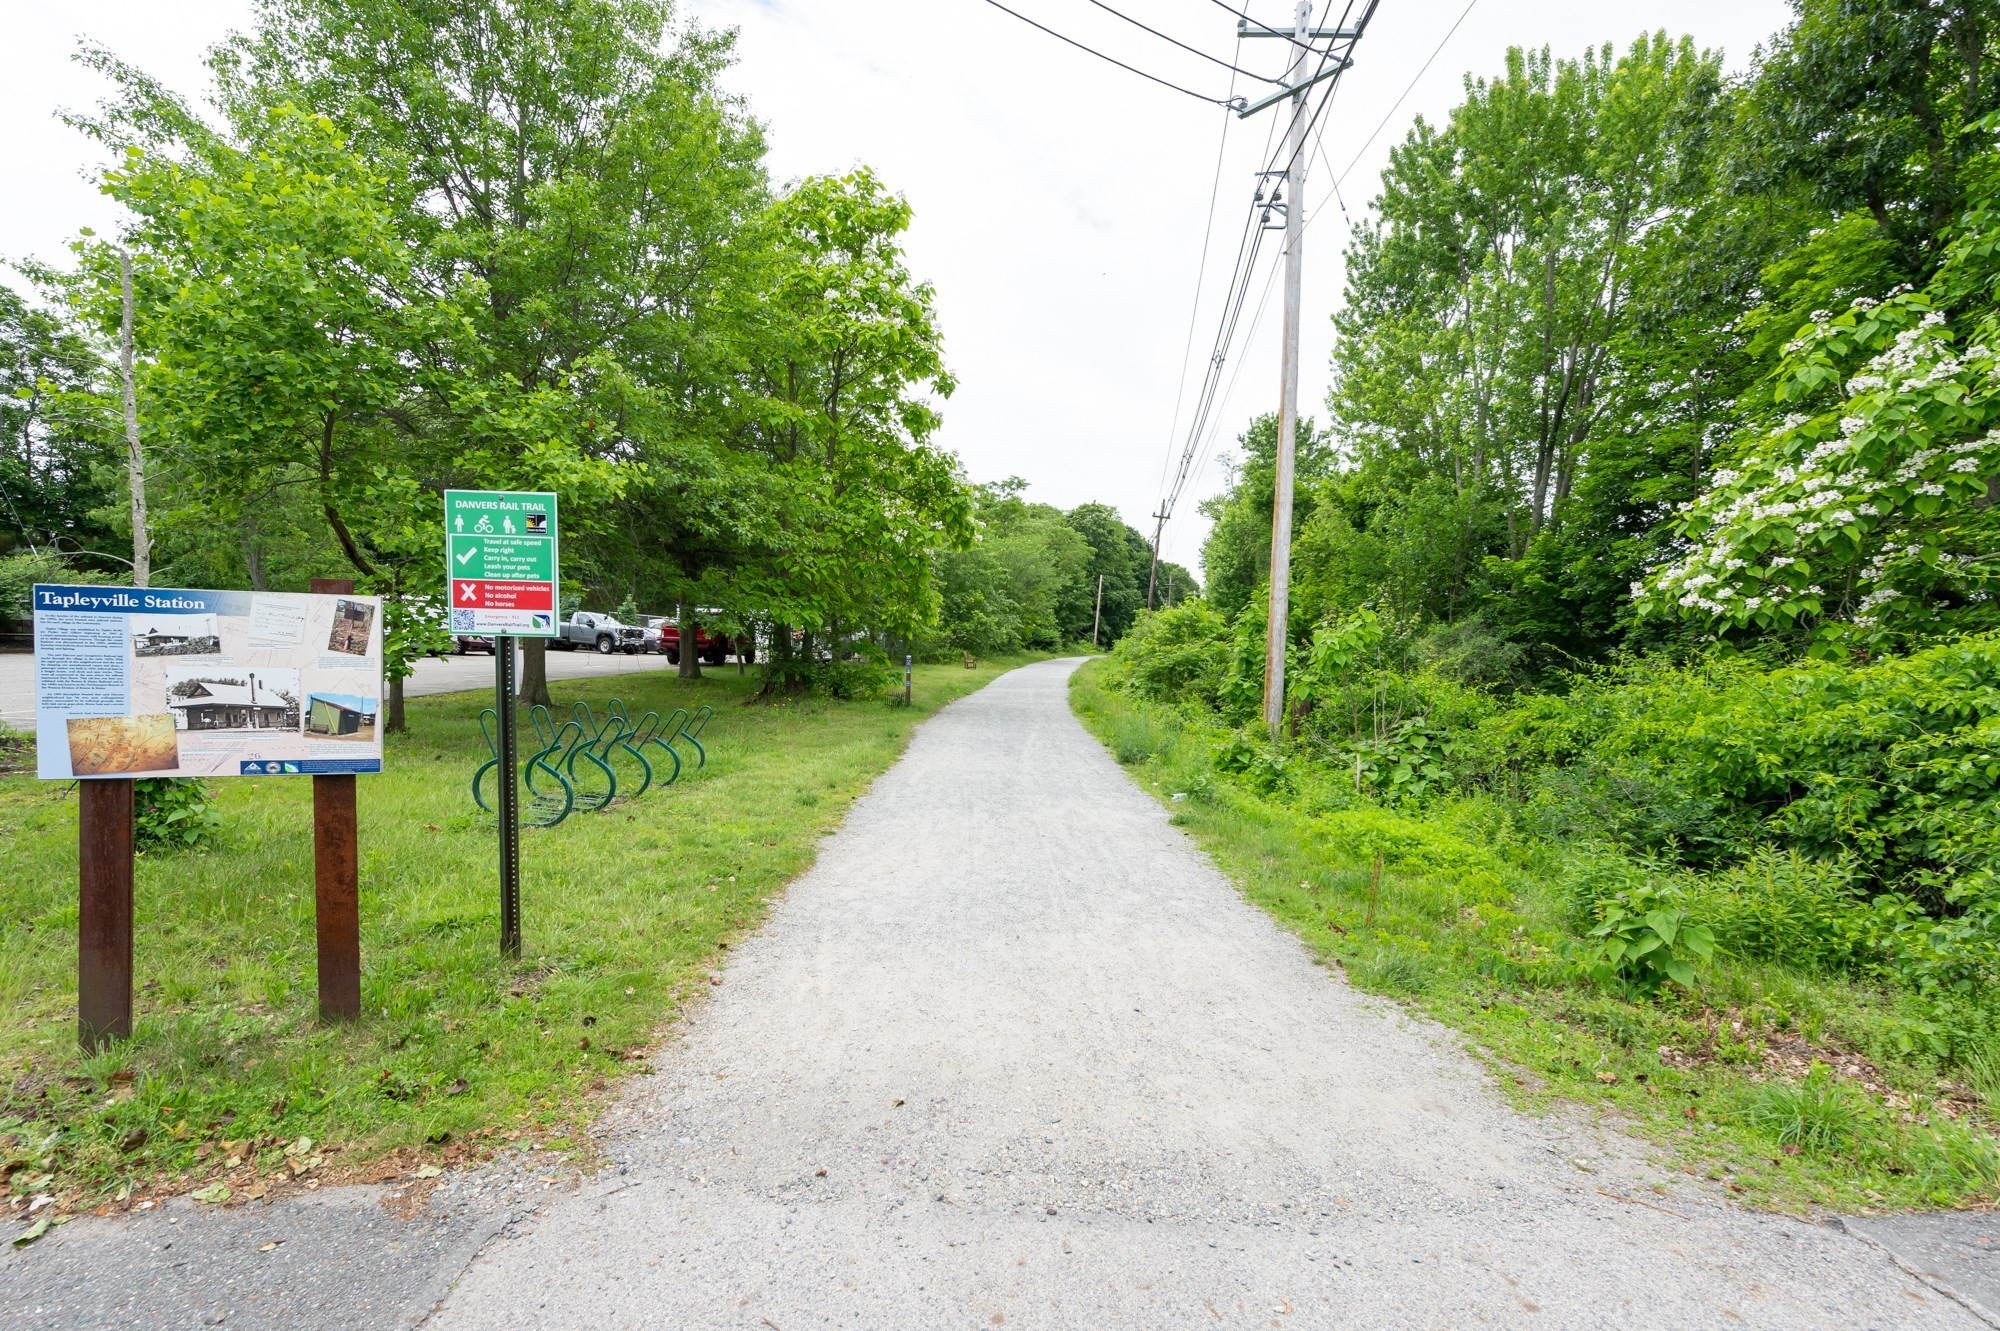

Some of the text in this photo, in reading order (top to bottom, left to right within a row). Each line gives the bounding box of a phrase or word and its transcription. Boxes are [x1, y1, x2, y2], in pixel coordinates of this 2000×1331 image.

[456, 500, 546, 511] DANVERS RAIL TRAIL
[39, 592, 206, 609] Tapleyville Station
